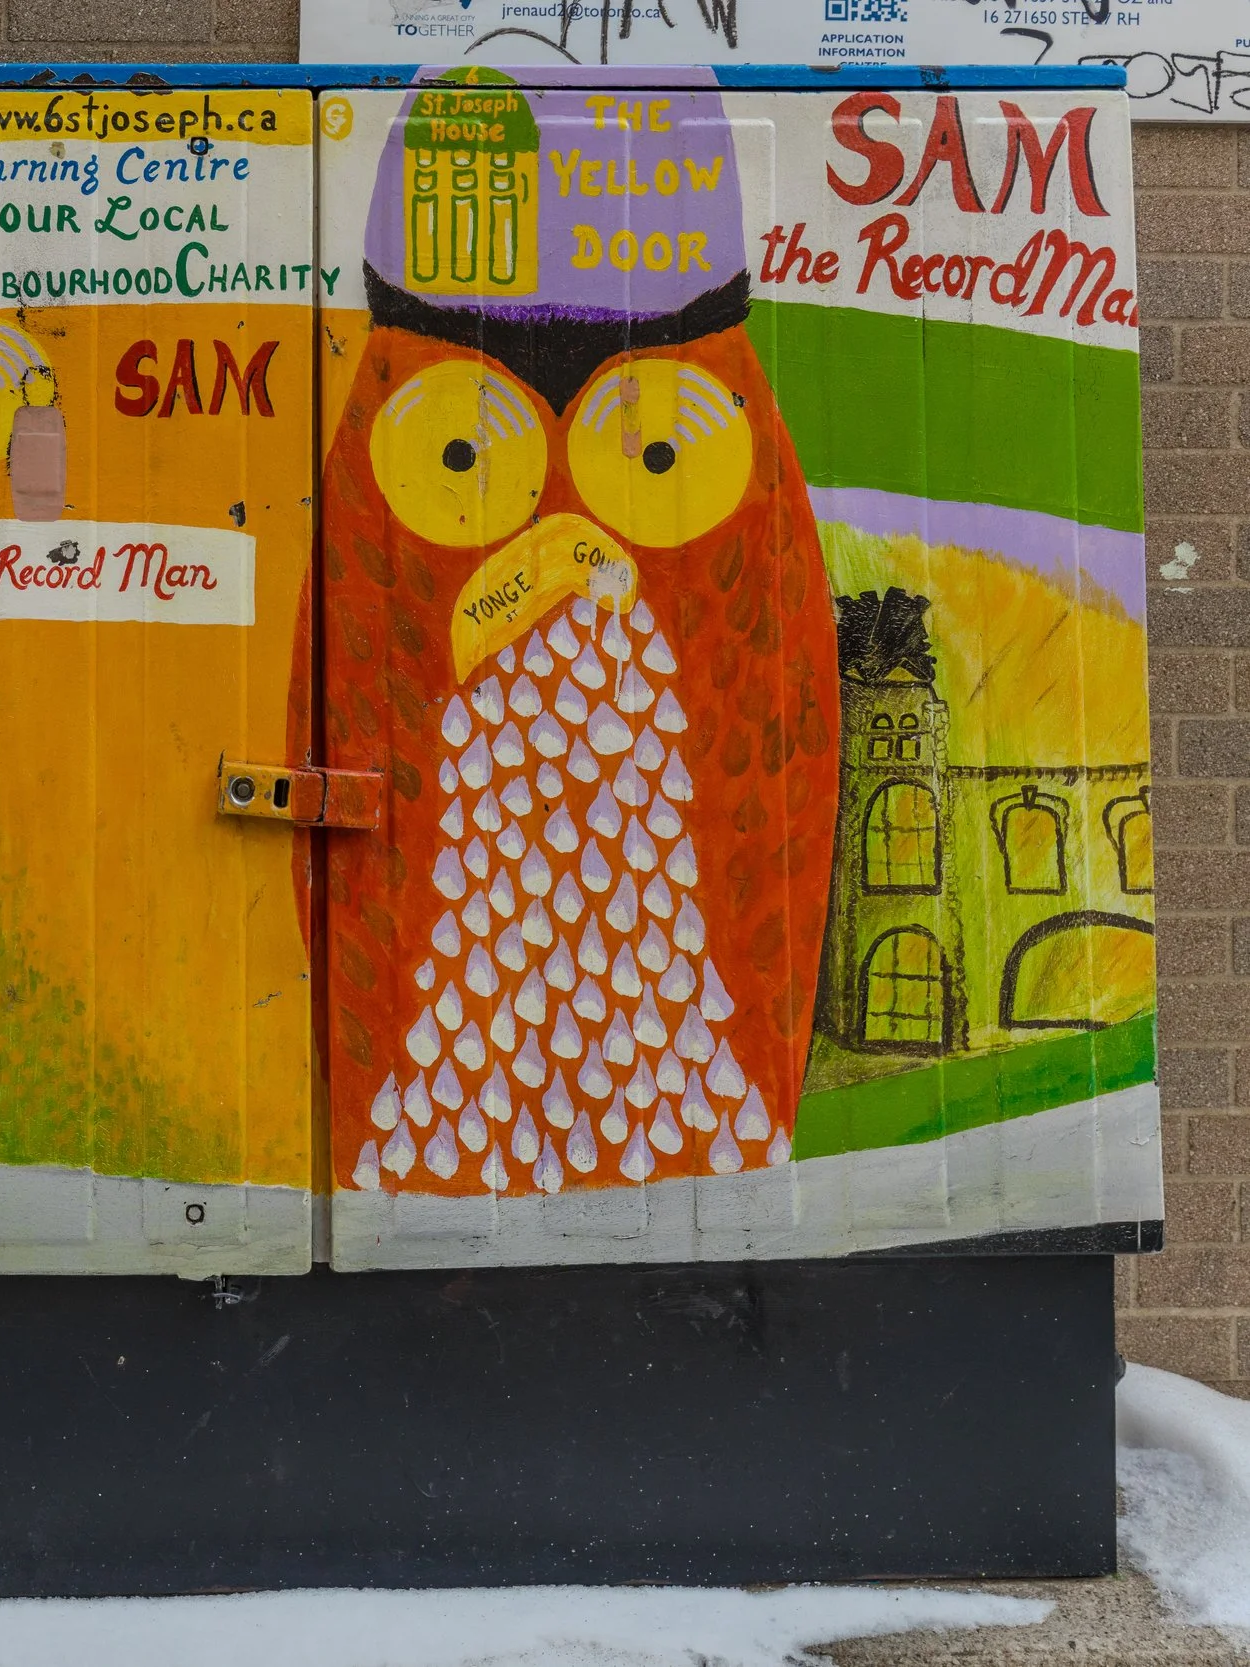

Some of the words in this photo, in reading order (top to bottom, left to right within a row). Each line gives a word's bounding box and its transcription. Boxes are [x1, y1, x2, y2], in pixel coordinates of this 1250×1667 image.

[394, 24, 475, 37] TOGETHER
[502, 3, 660, 20] jrenaud2@torono.ca
[984, 9, 999, 24] 16
[1004, 10, 1057, 25] 271650
[1062, 11, 1090, 25] STE
[1117, 12, 1140, 26] RH
[818, 47, 905, 57] INFORMATION
[821, 34, 904, 44] APPLICATION
[420, 93, 446, 116] St.
[450, 91, 519, 119] Joseph
[585, 95, 672, 132] THE
[430, 119, 505, 142] House
[115, 138, 250, 186] Centre
[549, 148, 724, 198] YELLOW
[826, 92, 1111, 217] SAM
[94, 195, 230, 241] LOCAL
[571, 224, 712, 274] DOOR
[759, 222, 840, 285] the
[855, 212, 1045, 308] Record
[114, 338, 280, 419] SAM
[112, 543, 218, 600] Man
[463, 572, 533, 625] YONGE
